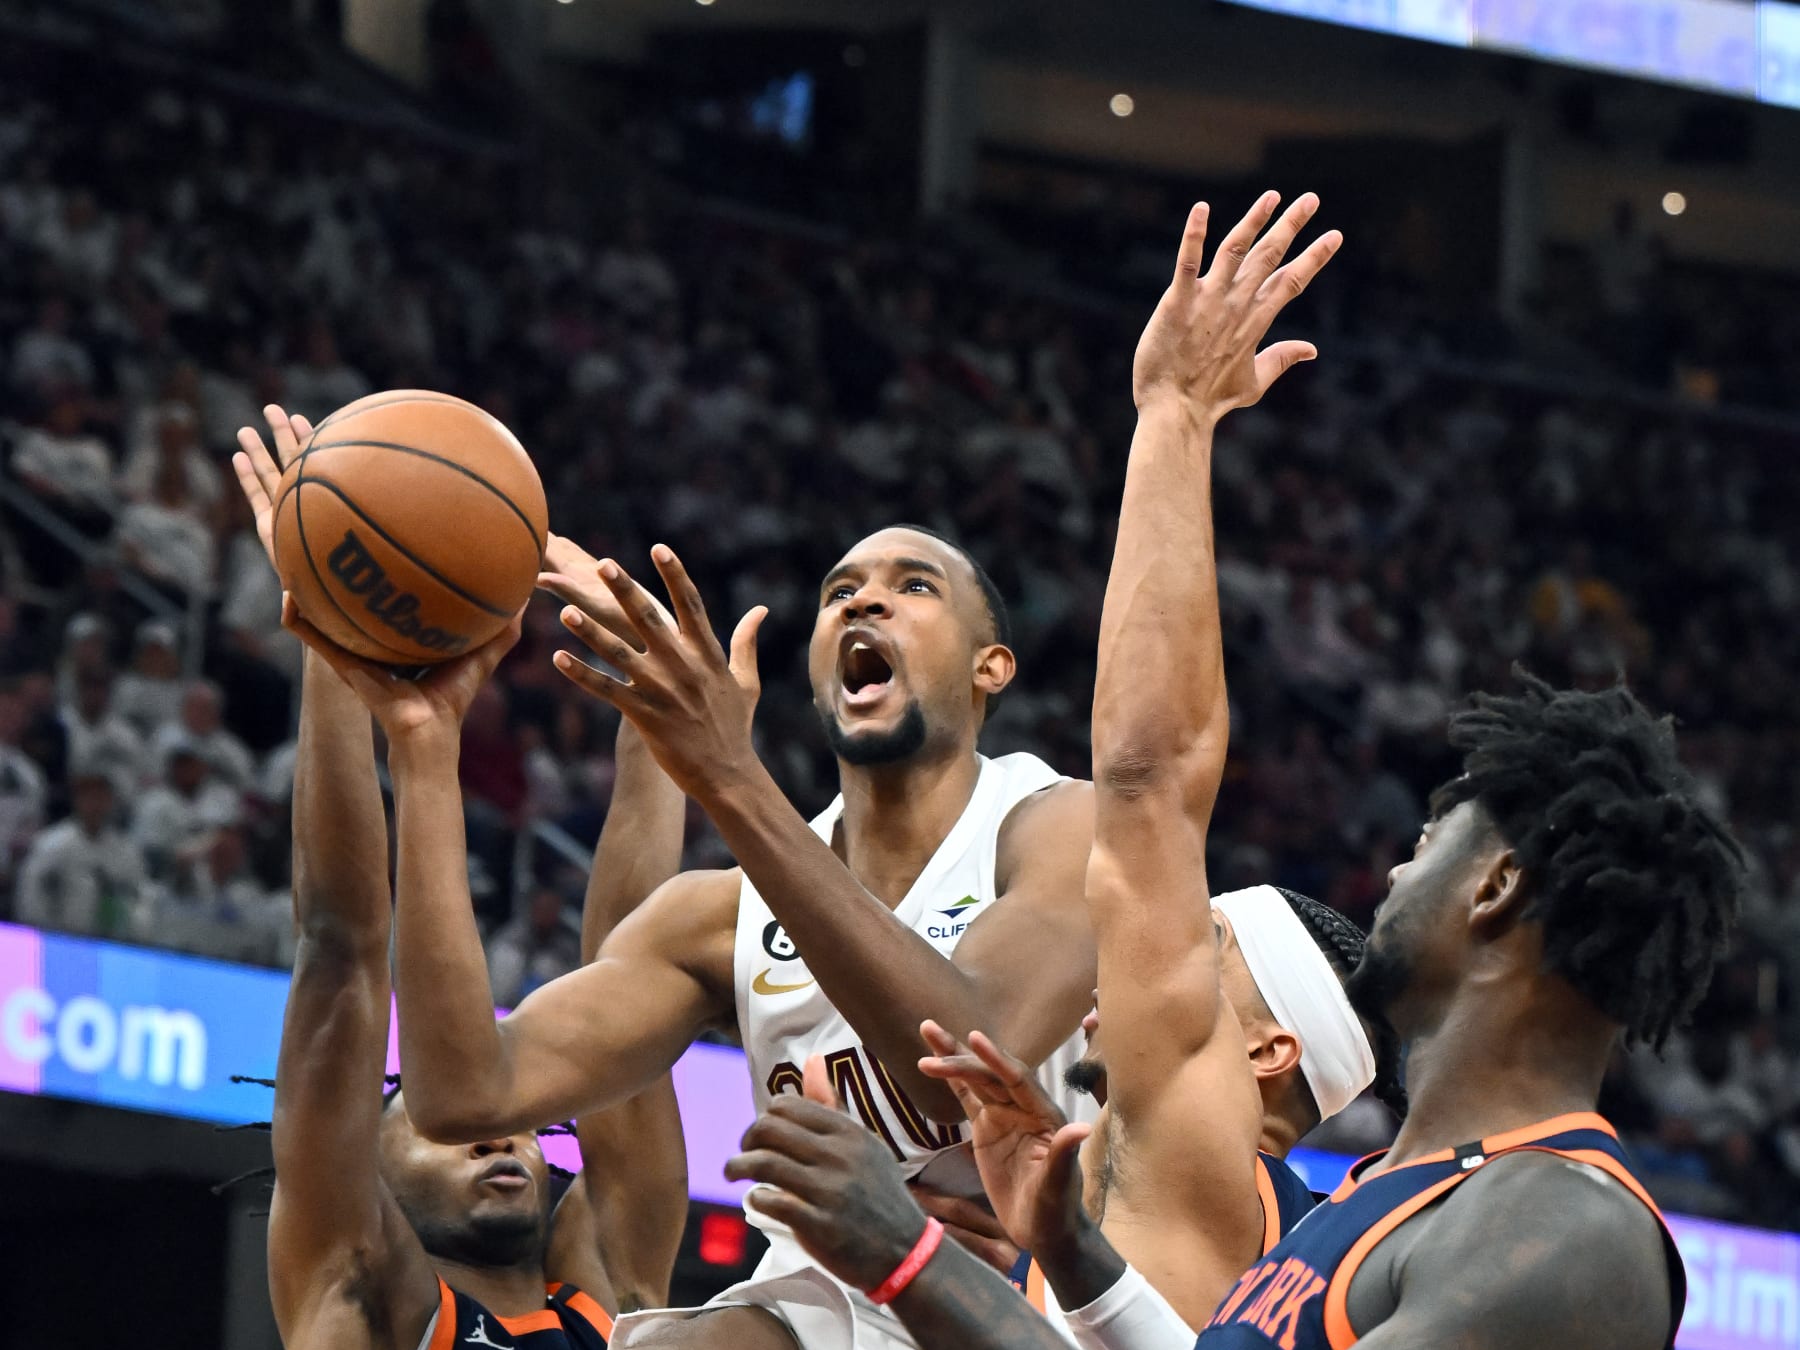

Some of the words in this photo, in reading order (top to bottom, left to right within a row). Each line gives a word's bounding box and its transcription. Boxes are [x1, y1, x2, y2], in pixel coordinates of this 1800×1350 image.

[327, 527, 471, 653] Wilson
[927, 922, 972, 939] CLIF
[3, 986, 208, 1091] com
